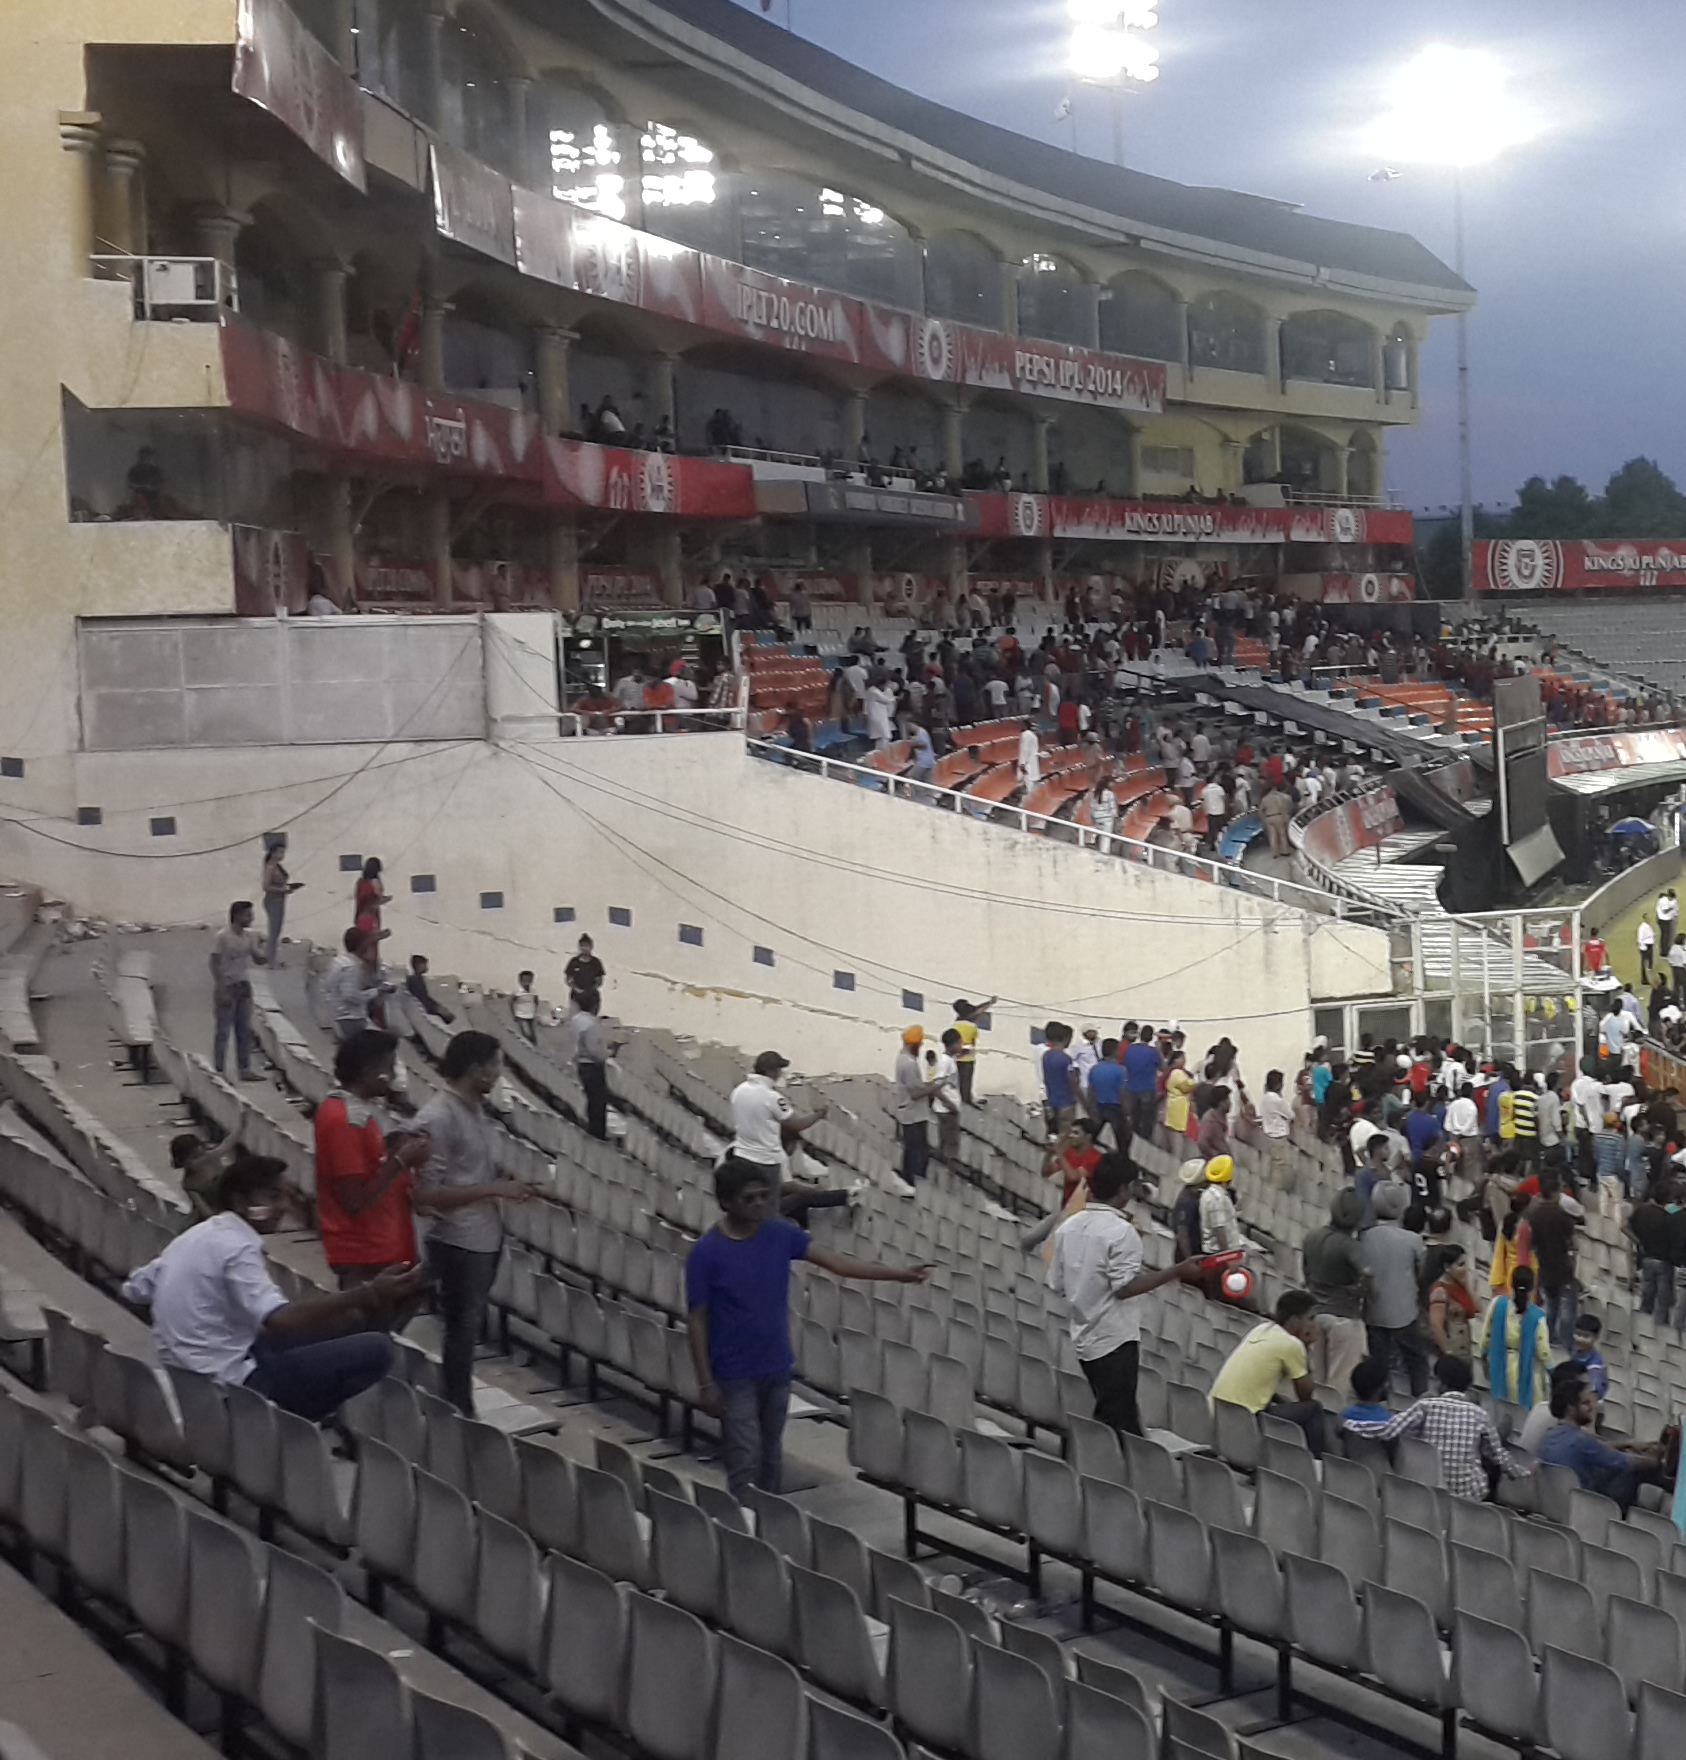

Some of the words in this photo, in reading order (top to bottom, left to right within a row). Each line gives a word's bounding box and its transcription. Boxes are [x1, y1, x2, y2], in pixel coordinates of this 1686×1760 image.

[737, 283, 834, 342] IPLT20.COM
[1015, 350, 1056, 386] PEPSI
[1059, 359, 1084, 390] IPL
[1087, 364, 1123, 397] 2014
[1125, 511, 1160, 533] KINGS
[1174, 513, 1215, 536] PUNJAB
[1585, 555, 1624, 571] KINGS
[1412, 1171, 1430, 1197] 9
